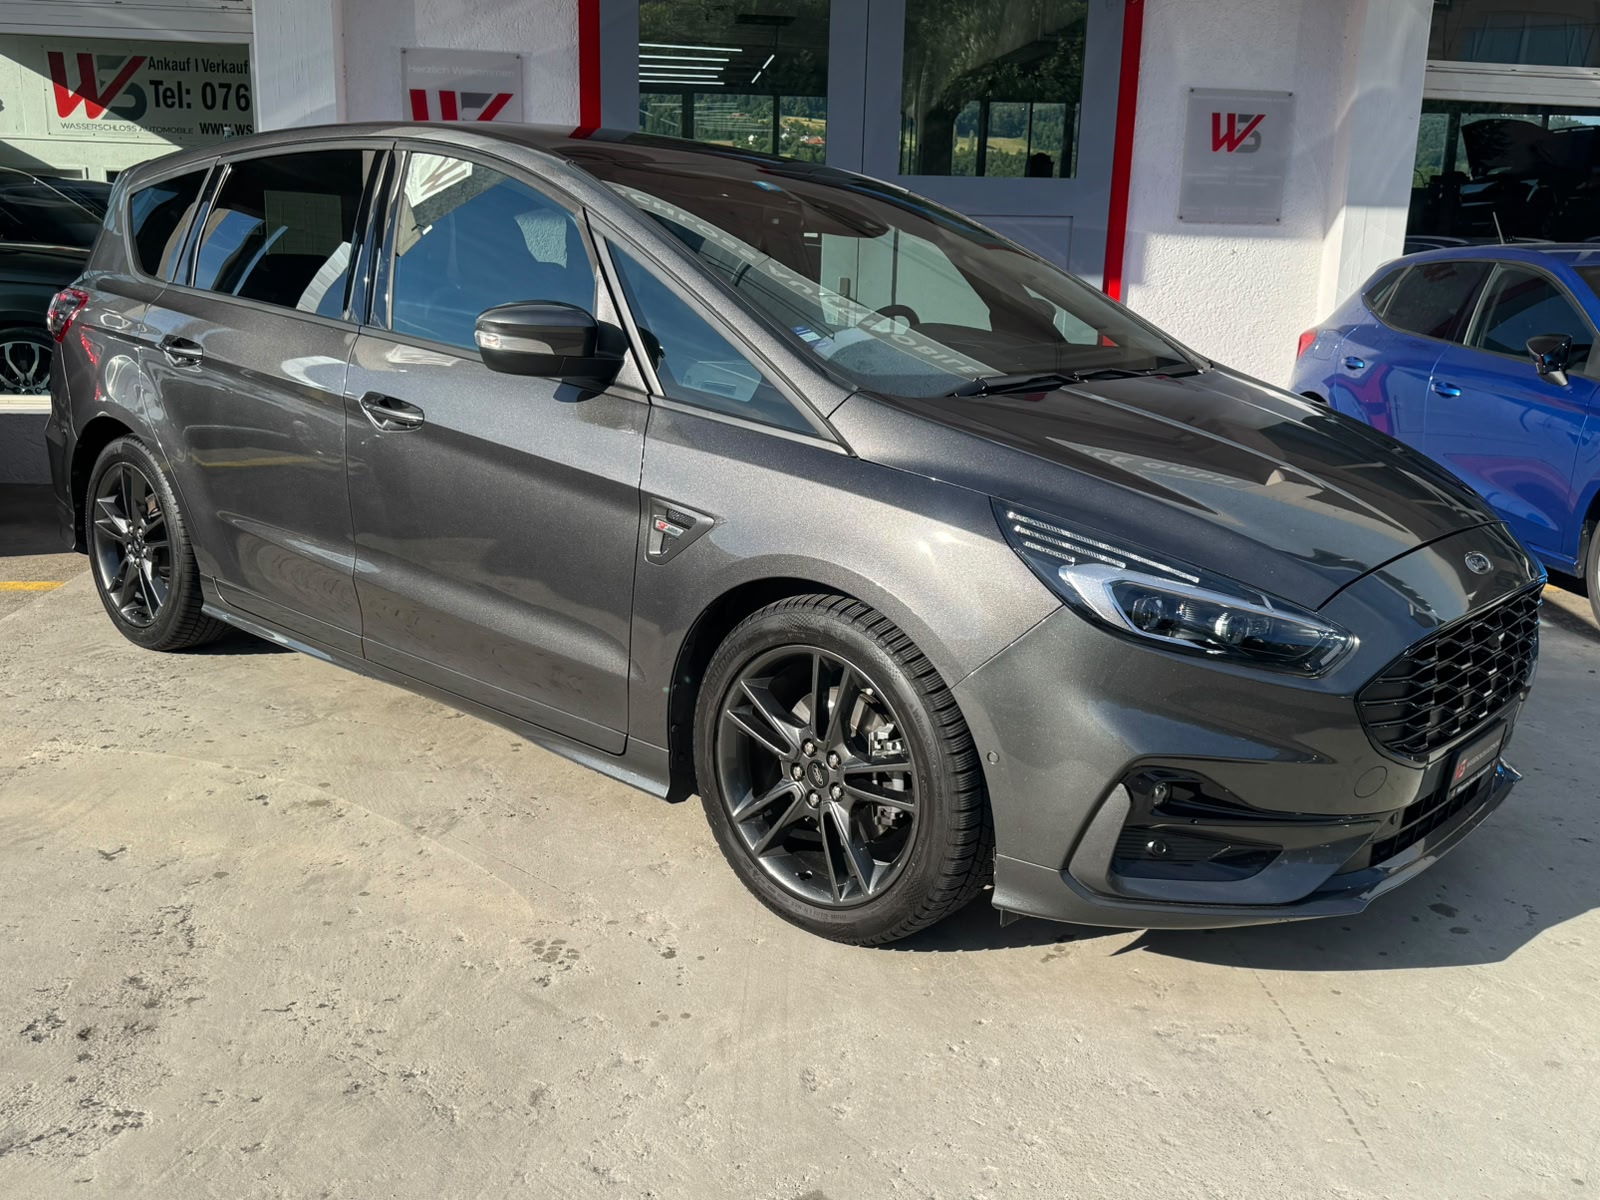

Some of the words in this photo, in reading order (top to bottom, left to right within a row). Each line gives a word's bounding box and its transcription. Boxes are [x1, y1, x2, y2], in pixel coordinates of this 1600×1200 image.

[148, 56, 191, 72] Ankauf
[201, 58, 249, 74] Verkauf
[149, 79, 192, 109] Tel:
[201, 81, 250, 112] 076
[60, 121, 137, 132] WASSERSCHLOSS
[139, 125, 194, 135] AUTOMOBILE
